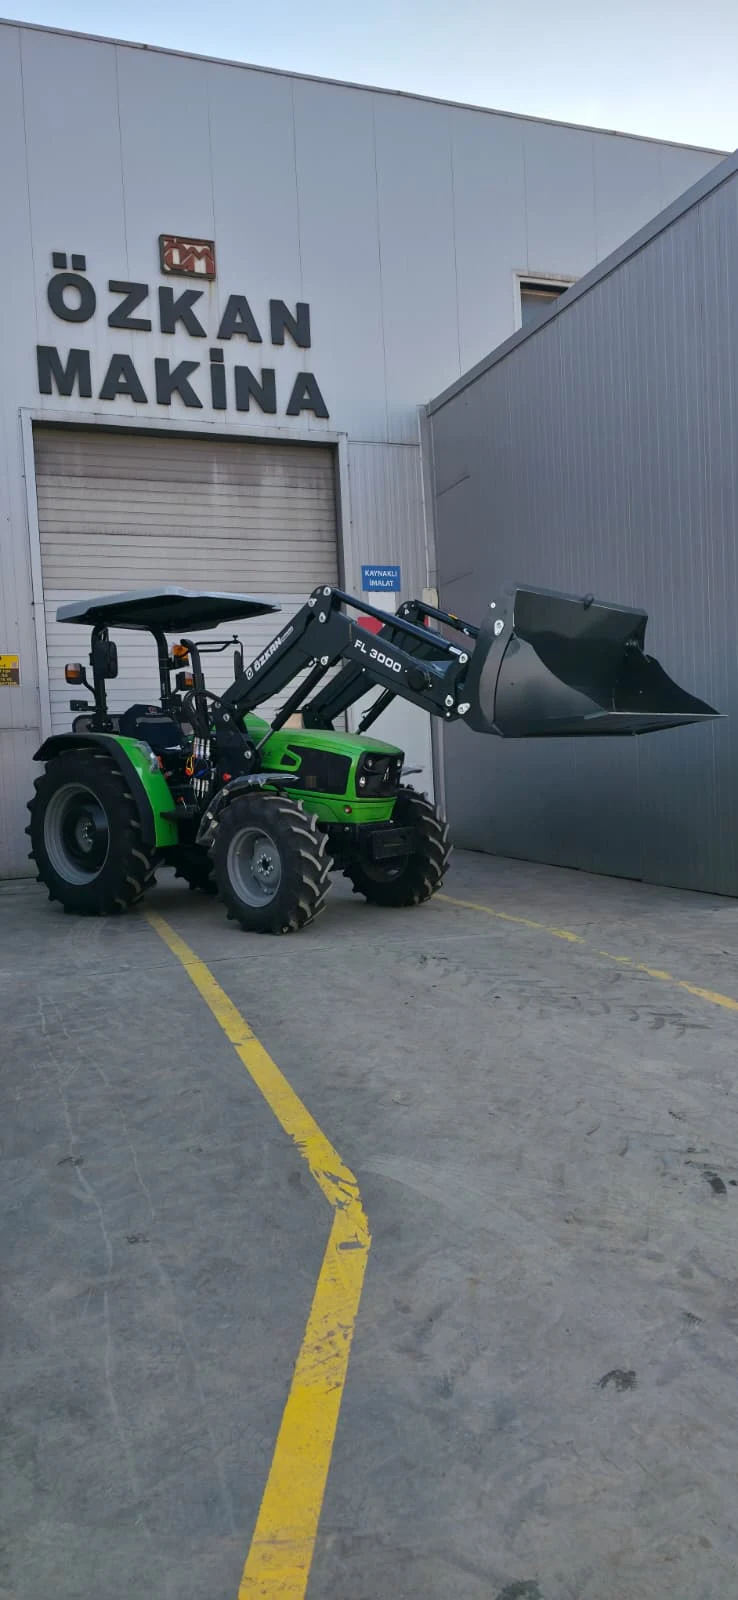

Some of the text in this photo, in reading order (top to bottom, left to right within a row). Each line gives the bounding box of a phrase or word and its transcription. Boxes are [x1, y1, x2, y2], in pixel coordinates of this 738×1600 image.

[47, 251, 312, 348] ÖZKAN
[36, 345, 330, 418] MAKİNA
[364, 569, 398, 577] KAYNAKLI
[354, 639, 402, 673] FL 3000
